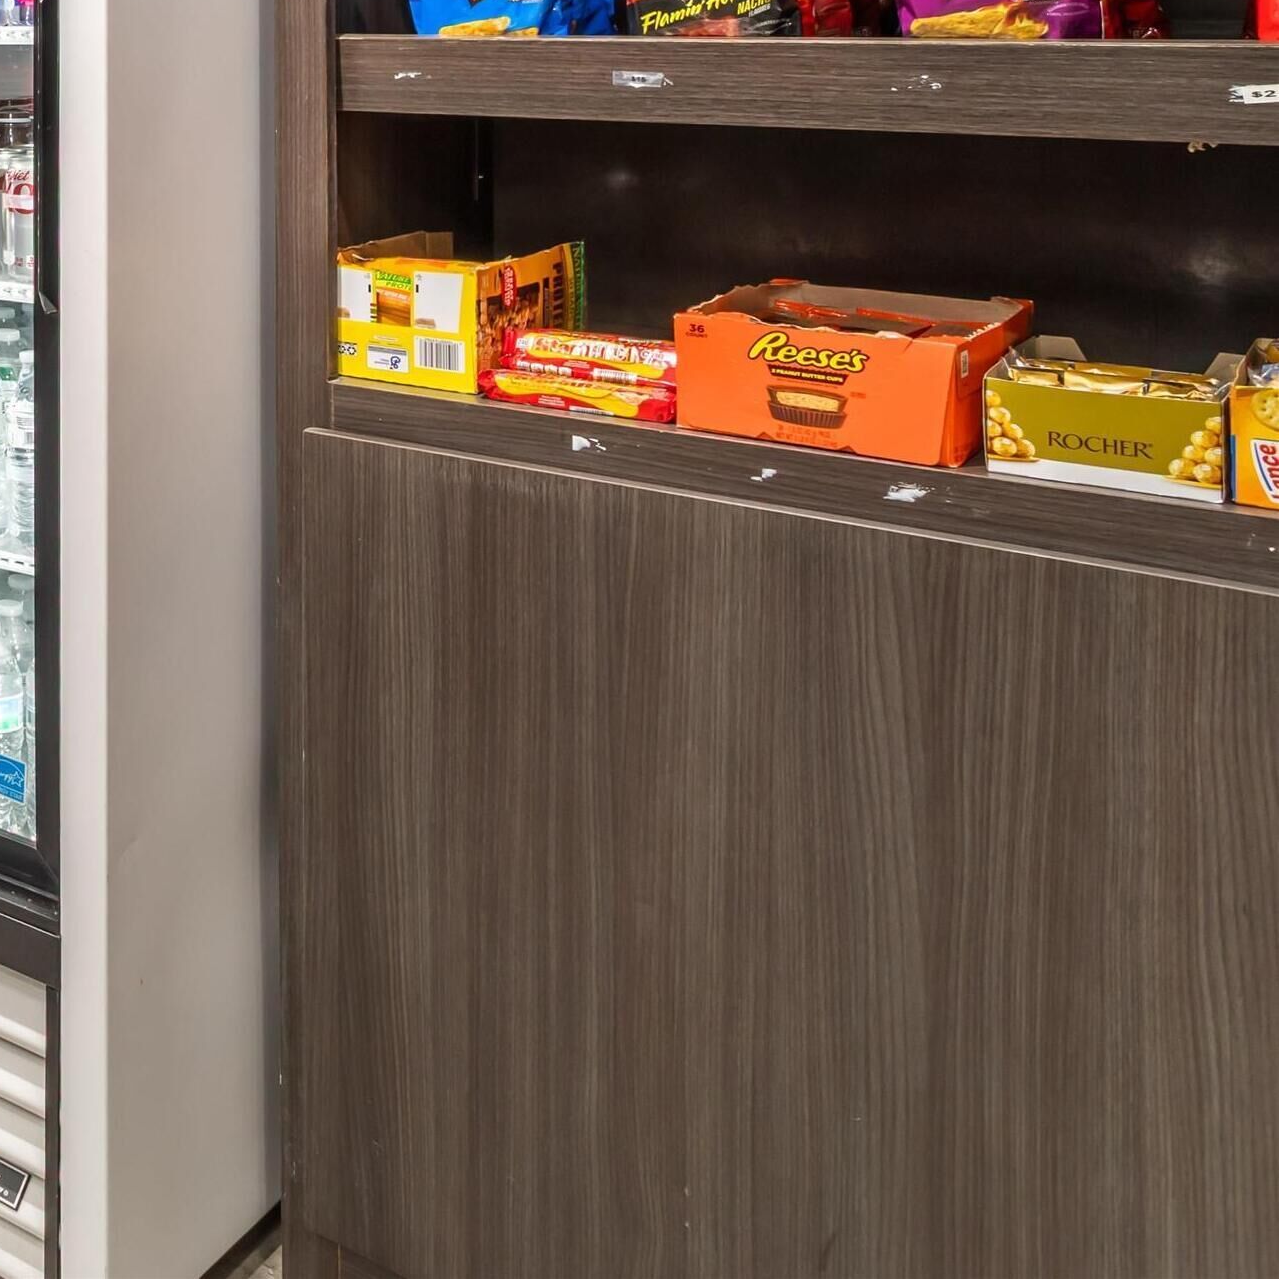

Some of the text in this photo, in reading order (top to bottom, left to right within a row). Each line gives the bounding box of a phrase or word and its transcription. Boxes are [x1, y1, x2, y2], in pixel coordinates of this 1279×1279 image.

[689, 324, 705, 333] 36
[748, 331, 869, 372] Reese's
[776, 369, 801, 377] PEANUT
[801, 371, 826, 380] BUTTER
[826, 374, 844, 383] CUPS
[1047, 430, 1150, 460] ROCHER
